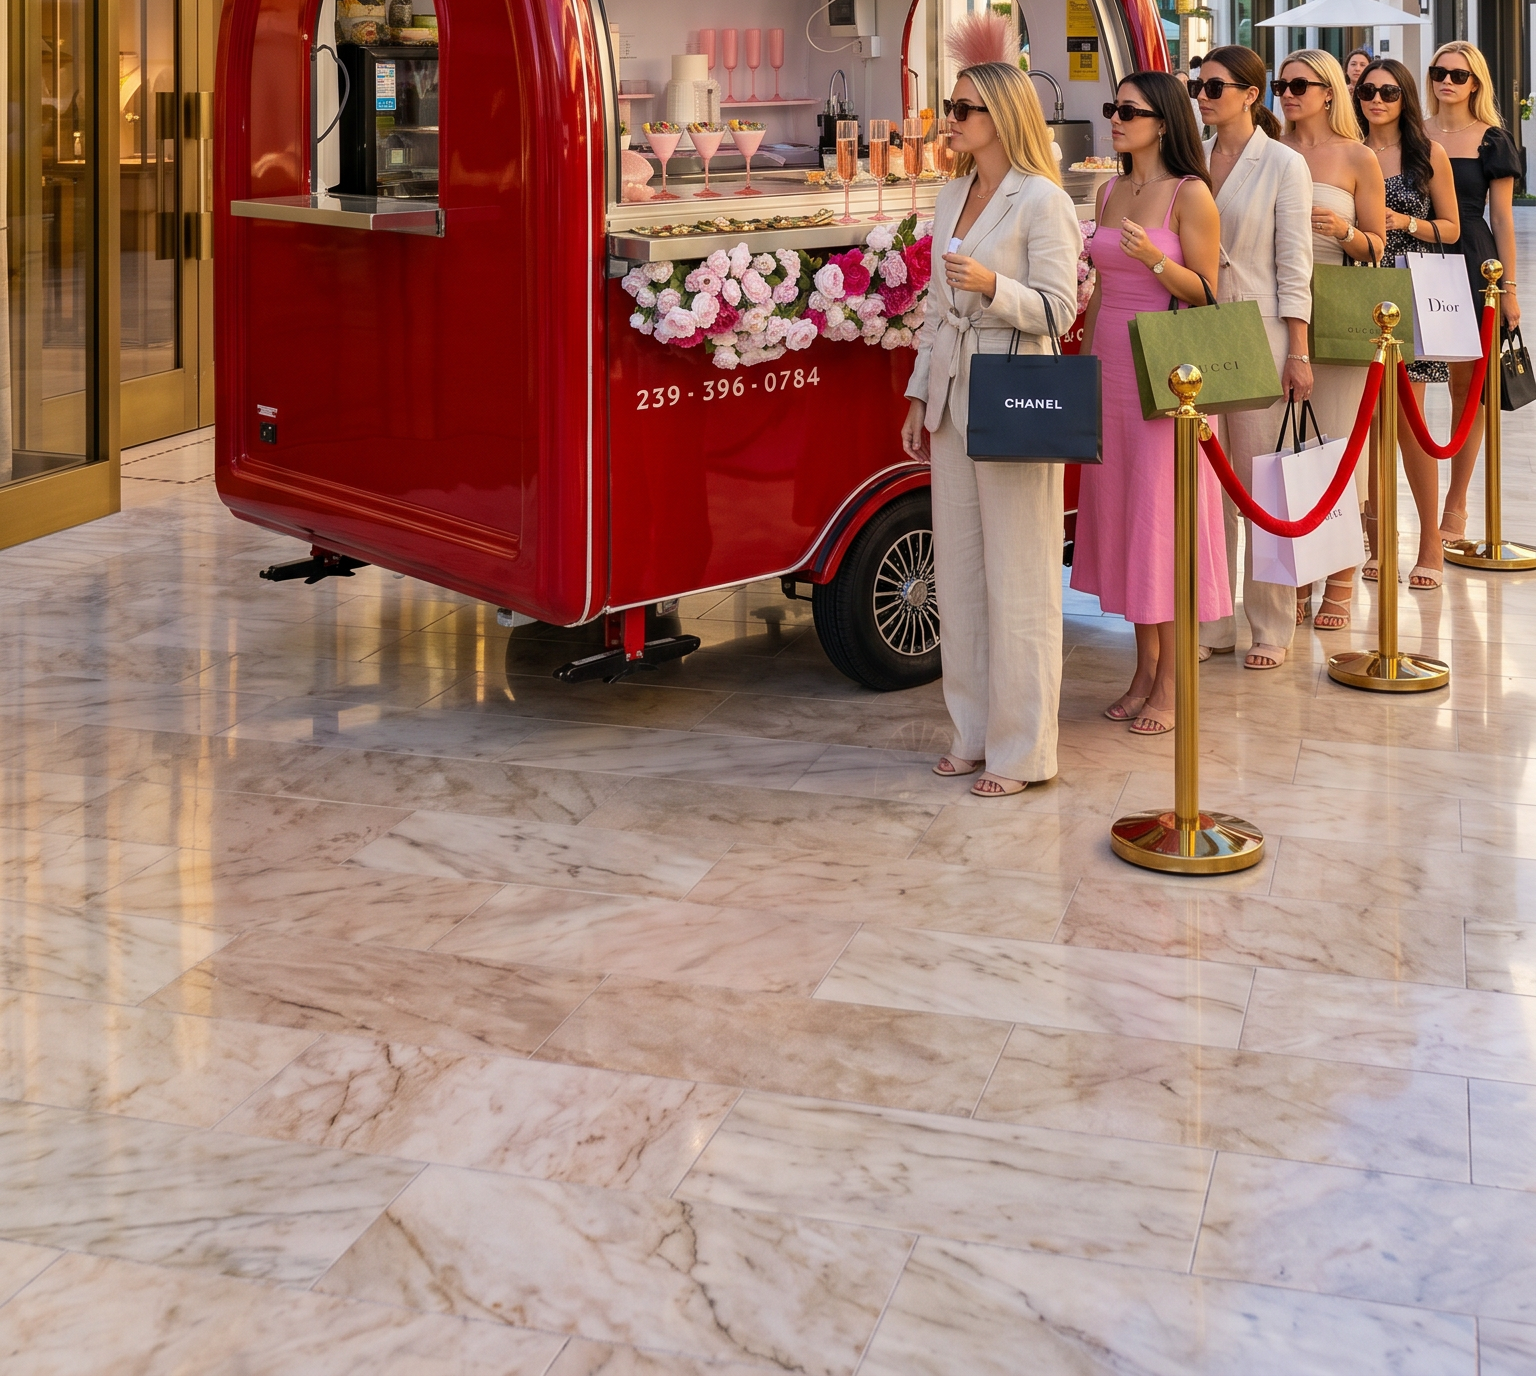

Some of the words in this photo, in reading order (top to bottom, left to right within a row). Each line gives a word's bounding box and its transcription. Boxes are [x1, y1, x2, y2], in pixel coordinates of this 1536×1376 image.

[1427, 297, 1460, 313] Dior
[1198, 360, 1240, 374] UCCI
[1004, 398, 1063, 410] CHANEL
